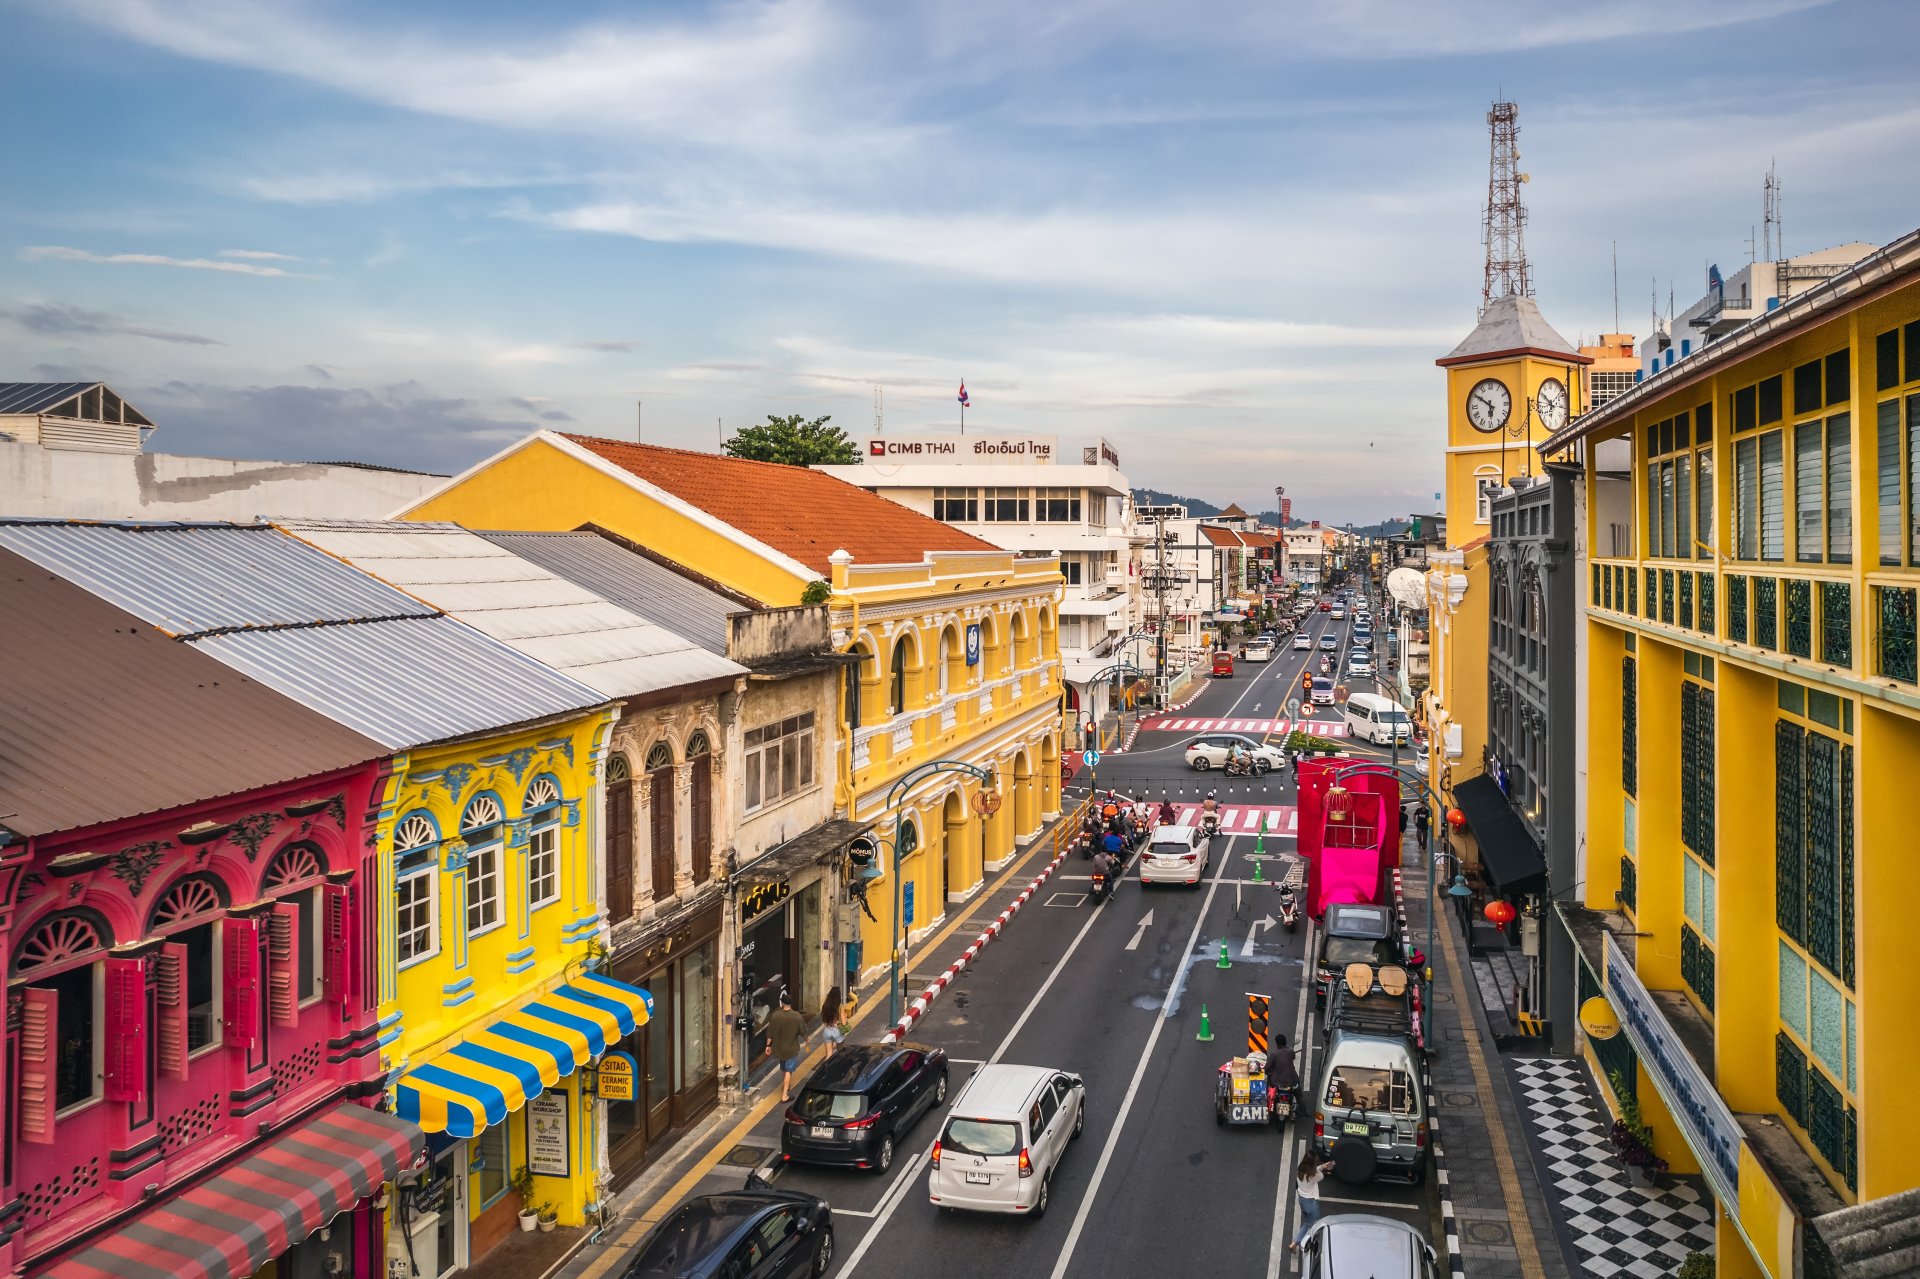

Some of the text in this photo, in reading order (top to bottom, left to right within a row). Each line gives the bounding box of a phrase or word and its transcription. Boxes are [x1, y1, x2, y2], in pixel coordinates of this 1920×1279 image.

[888, 443, 955, 454] CIMB THAI
[973, 440, 1050, 454] ซีไอเอ็มบี ไทย
[602, 1076, 628, 1084] CERAMIC
[604, 1085, 626, 1094] STUDIO
